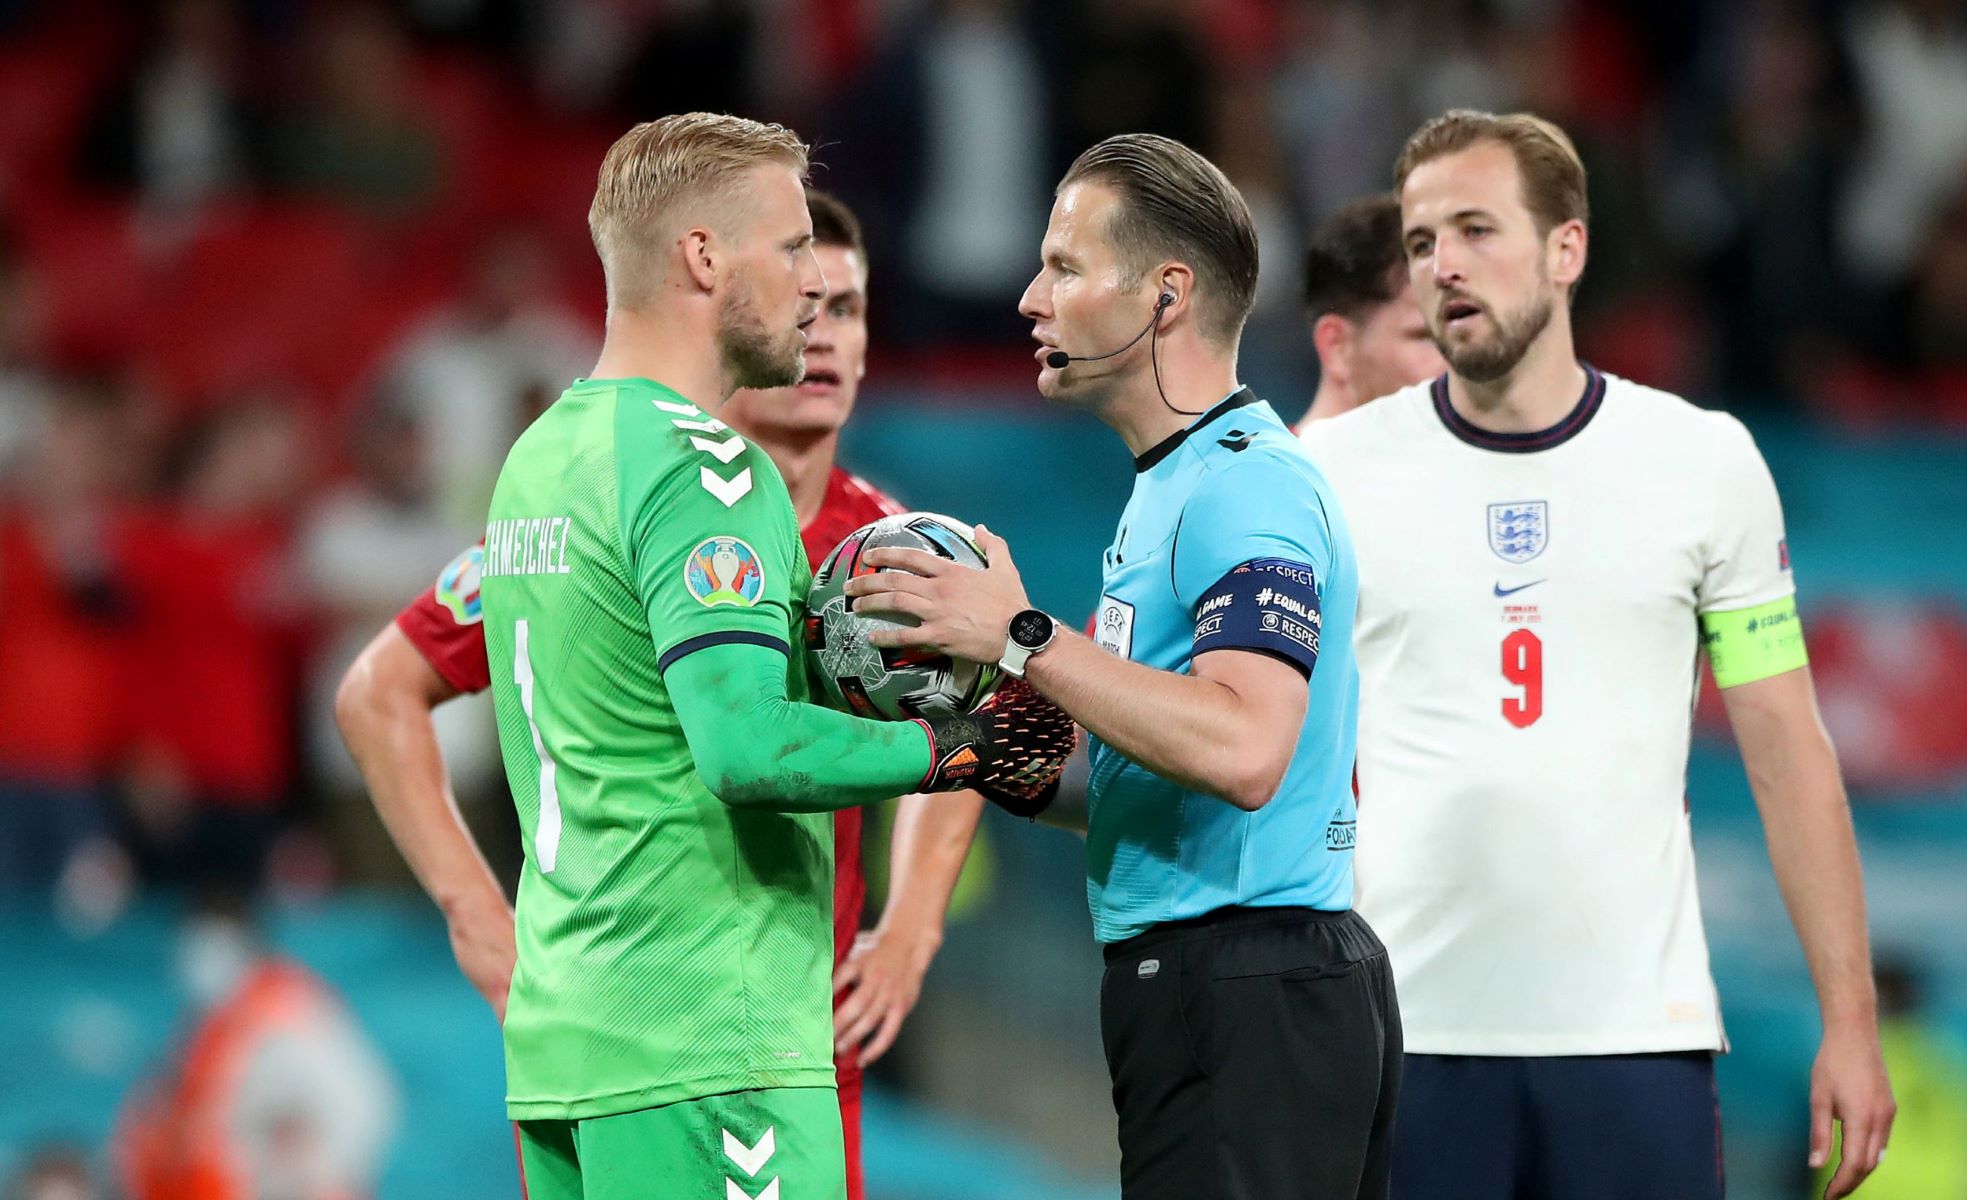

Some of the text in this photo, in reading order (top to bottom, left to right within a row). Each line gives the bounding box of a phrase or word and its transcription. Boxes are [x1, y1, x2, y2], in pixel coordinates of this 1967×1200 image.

[1255, 565, 1313, 586] SPECT
[1255, 587, 1322, 629] #EQUALGA
[1501, 628, 1542, 729] 9
[514, 619, 562, 874] 1
